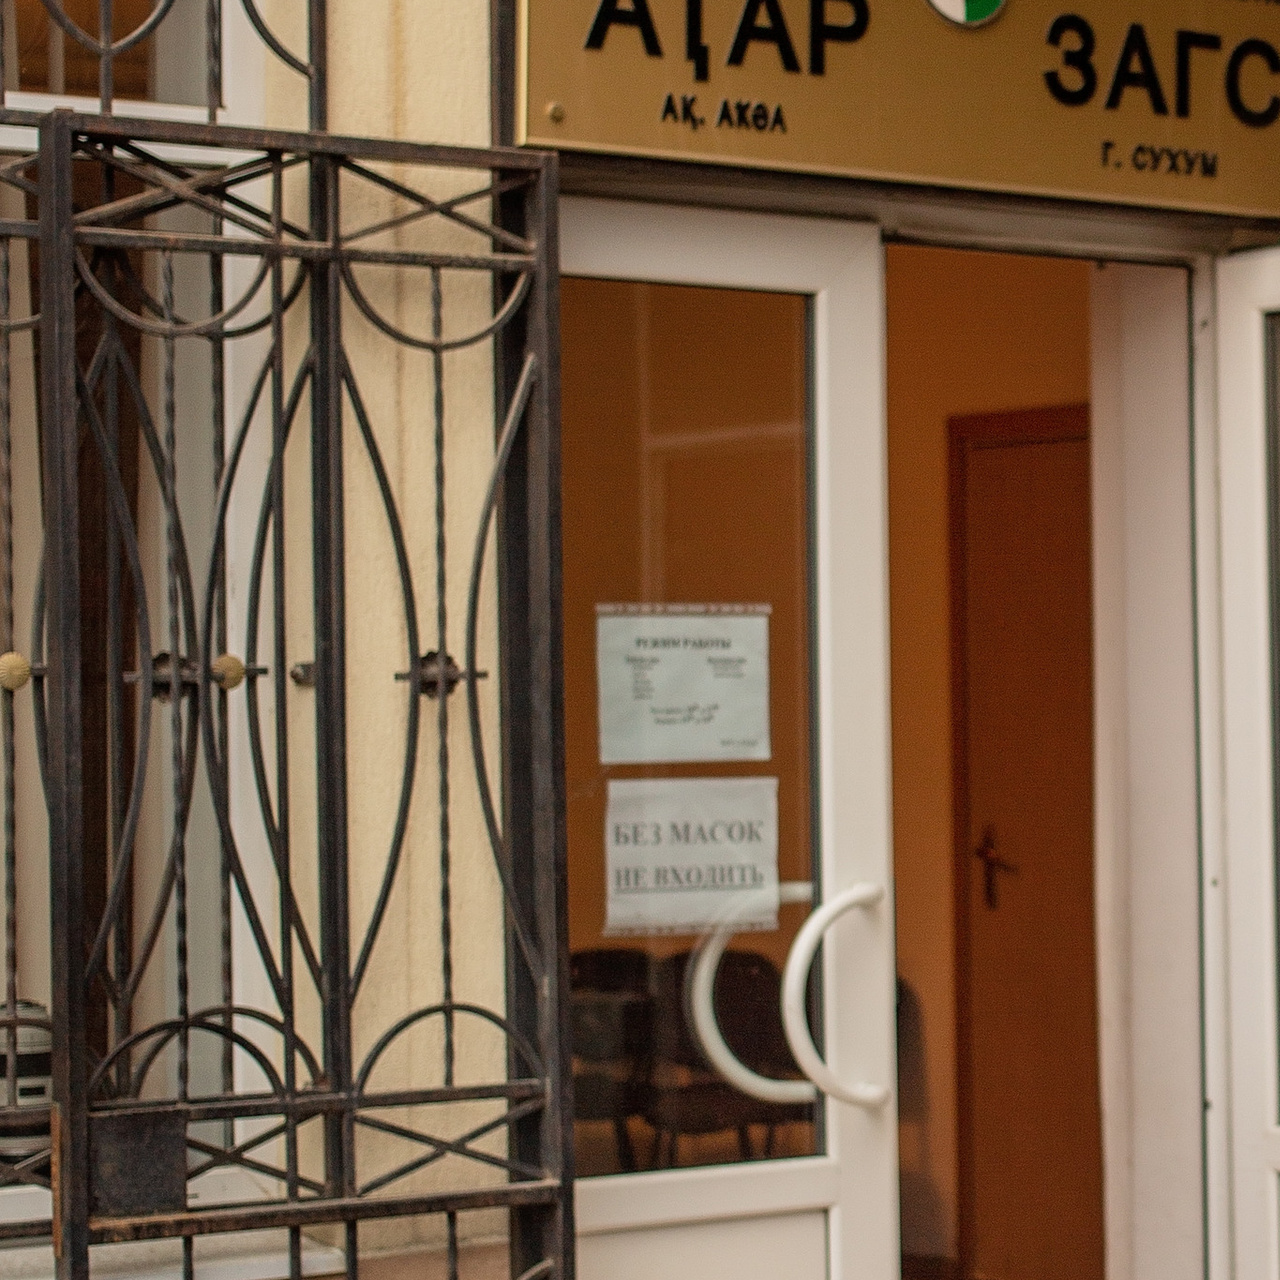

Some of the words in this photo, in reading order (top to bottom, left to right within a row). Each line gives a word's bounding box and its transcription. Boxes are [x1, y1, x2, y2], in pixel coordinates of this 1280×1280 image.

[1132, 145, 1218, 178] СУХУМ
[615, 821, 661, 846] БЕЗ
[670, 820, 763, 844] МАСОК
[615, 865, 648, 889] НЕ
[654, 863, 764, 889] ВХОДИТЬ
